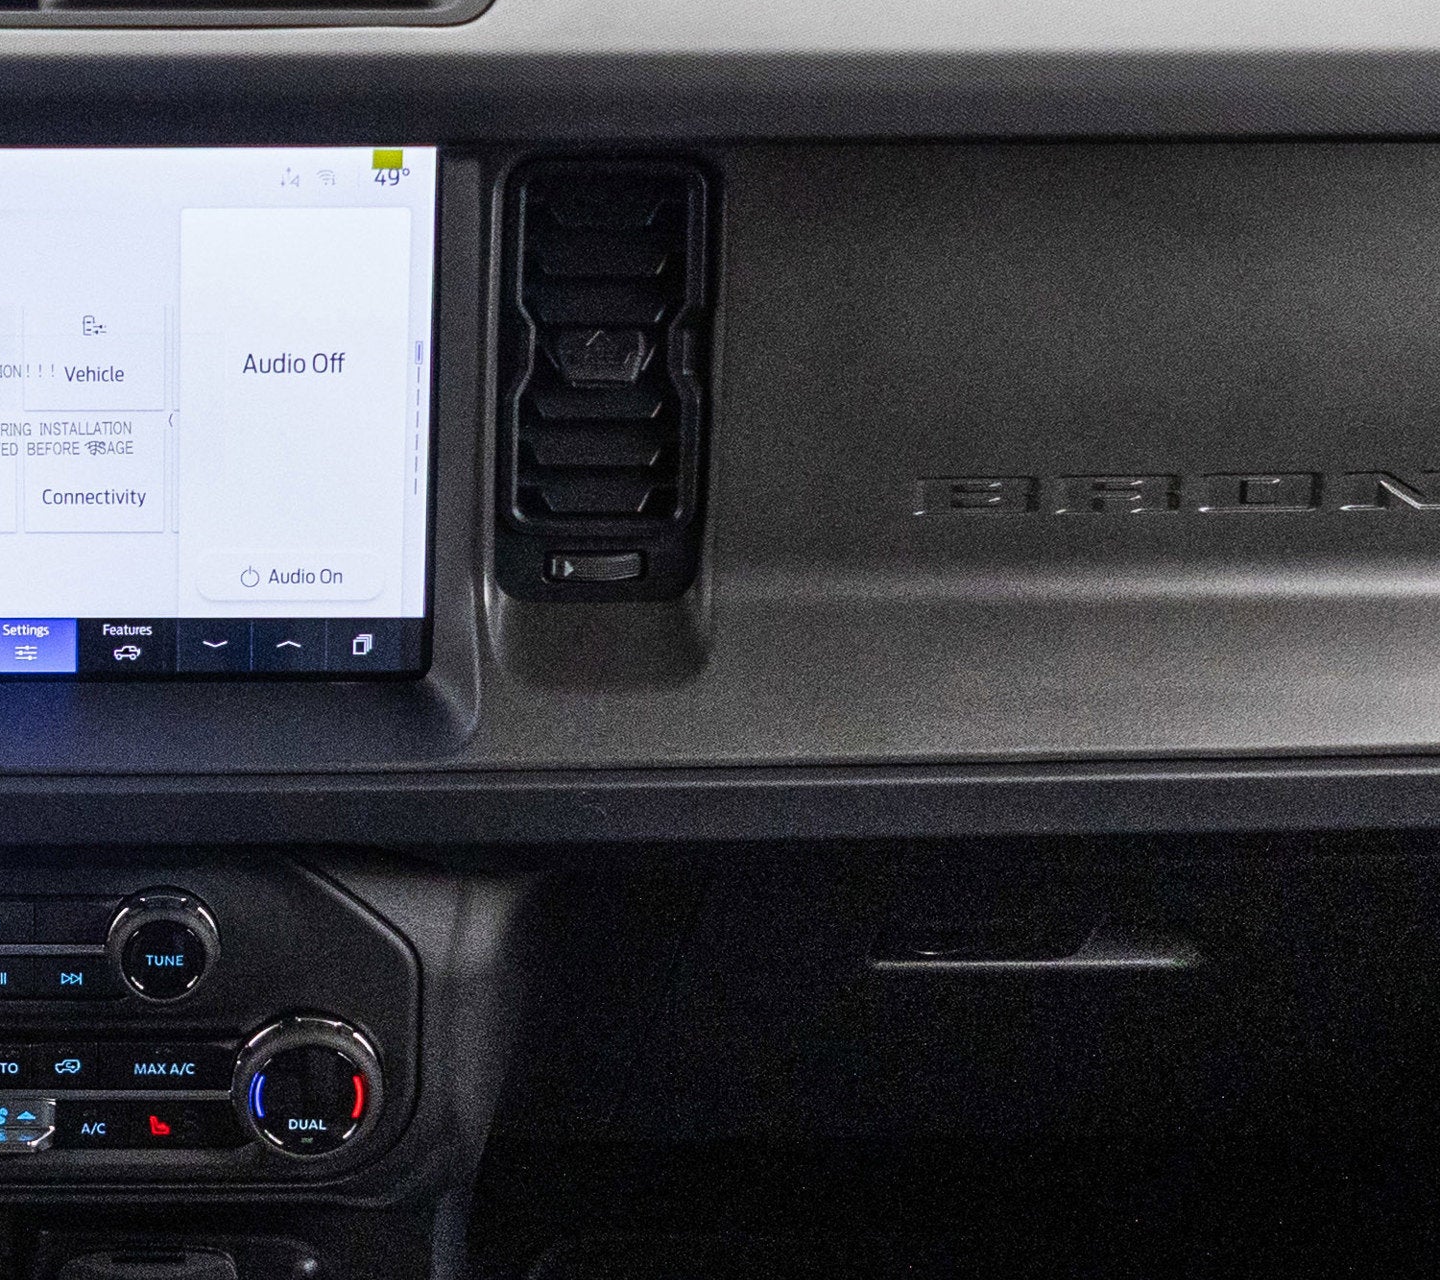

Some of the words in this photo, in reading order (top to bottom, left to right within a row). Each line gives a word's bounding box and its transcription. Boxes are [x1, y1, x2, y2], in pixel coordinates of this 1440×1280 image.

[374, 168, 410, 187] 49°
[242, 352, 306, 374] Audio
[311, 352, 346, 374] Off
[64, 365, 125, 383] Vehicle
[40, 422, 132, 436] INSTALLATION
[27, 442, 80, 456] BEFORE
[41, 488, 147, 508] Connectivity
[268, 568, 315, 585] Audio
[318, 567, 344, 585] On
[2, 623, 50, 638] Settings
[102, 623, 153, 636] Features
[145, 954, 184, 967] TUNE
[134, 1063, 161, 1075] MAX
[164, 1062, 195, 1076] A/C
[80, 1122, 106, 1136] A/C
[288, 1118, 327, 1131] DUAL
